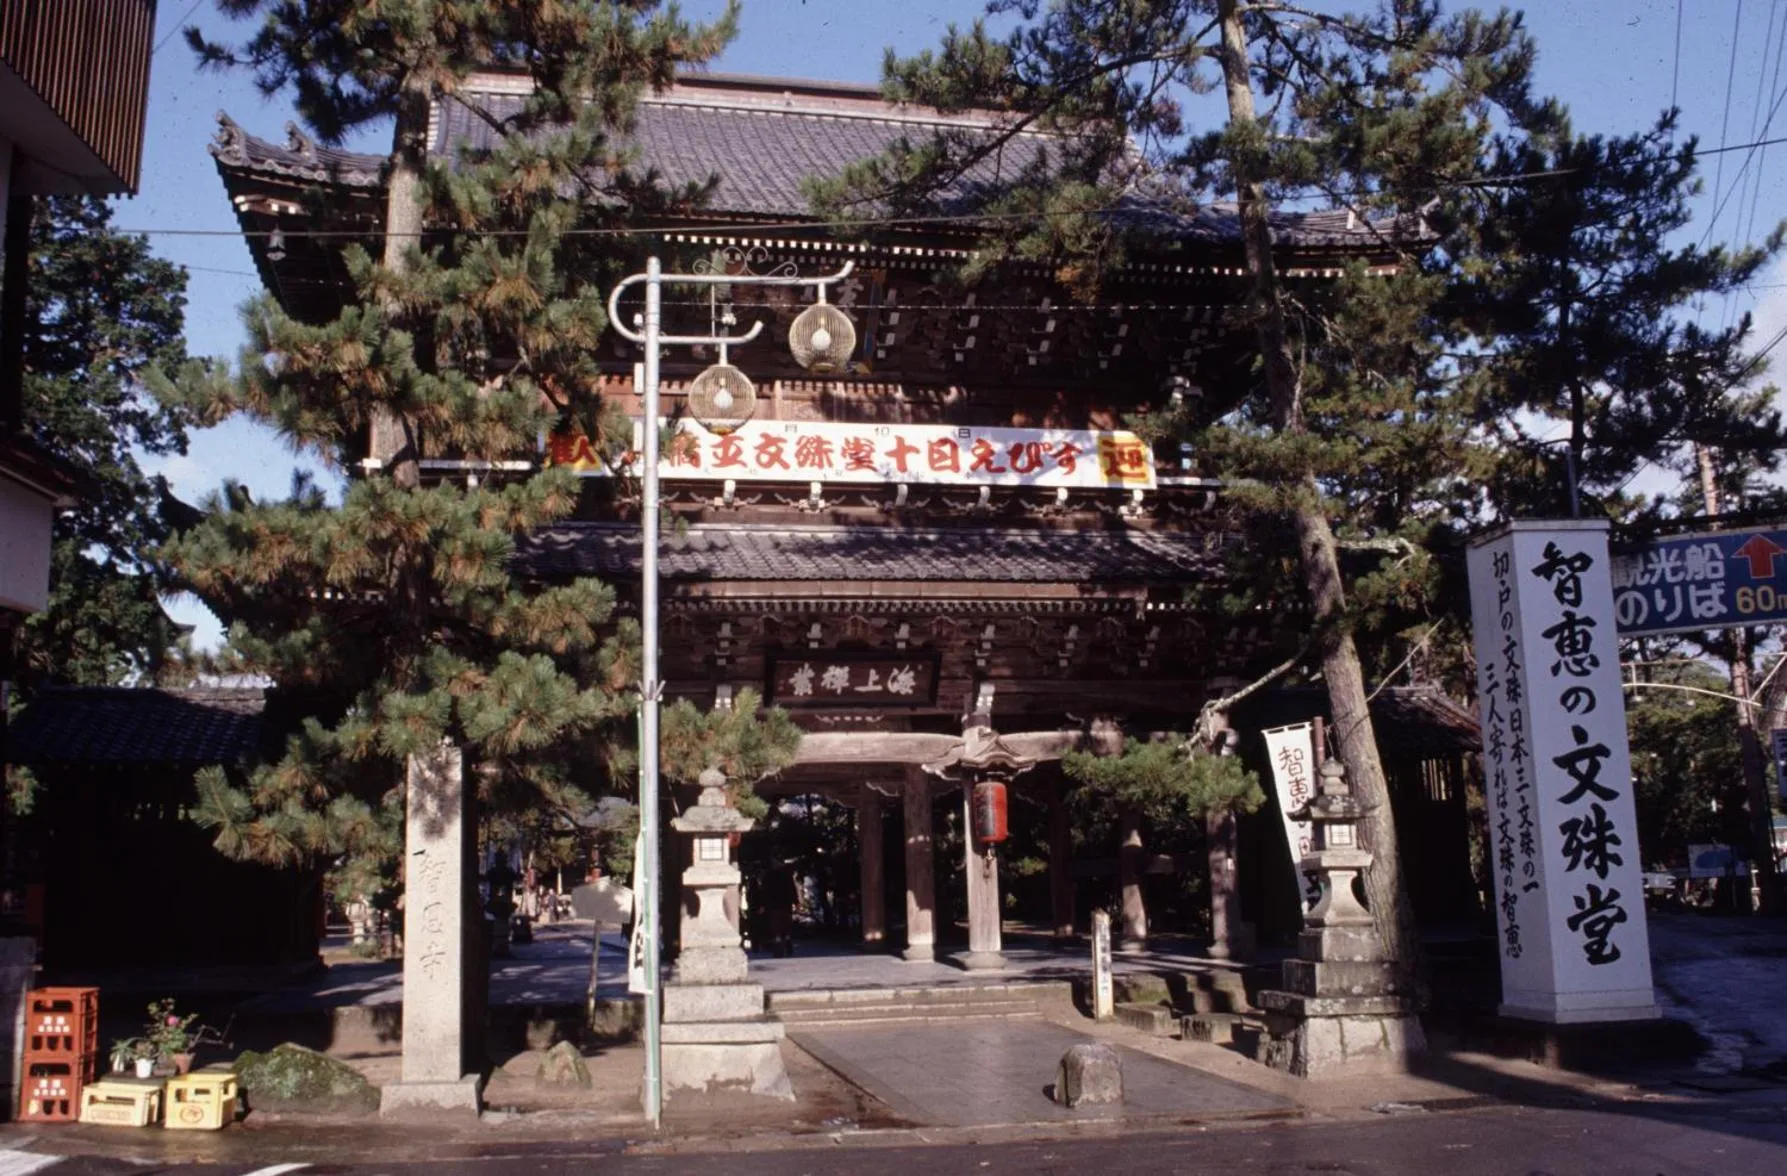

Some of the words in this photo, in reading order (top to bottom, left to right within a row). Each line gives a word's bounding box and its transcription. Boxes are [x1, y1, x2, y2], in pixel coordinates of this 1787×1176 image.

[1100, 440, 1147, 479] 迎
[1615, 581, 1728, 627] のりば
[1531, 540, 1629, 967] 智恵の文殊堂
[1277, 746, 1310, 828] 智恵
